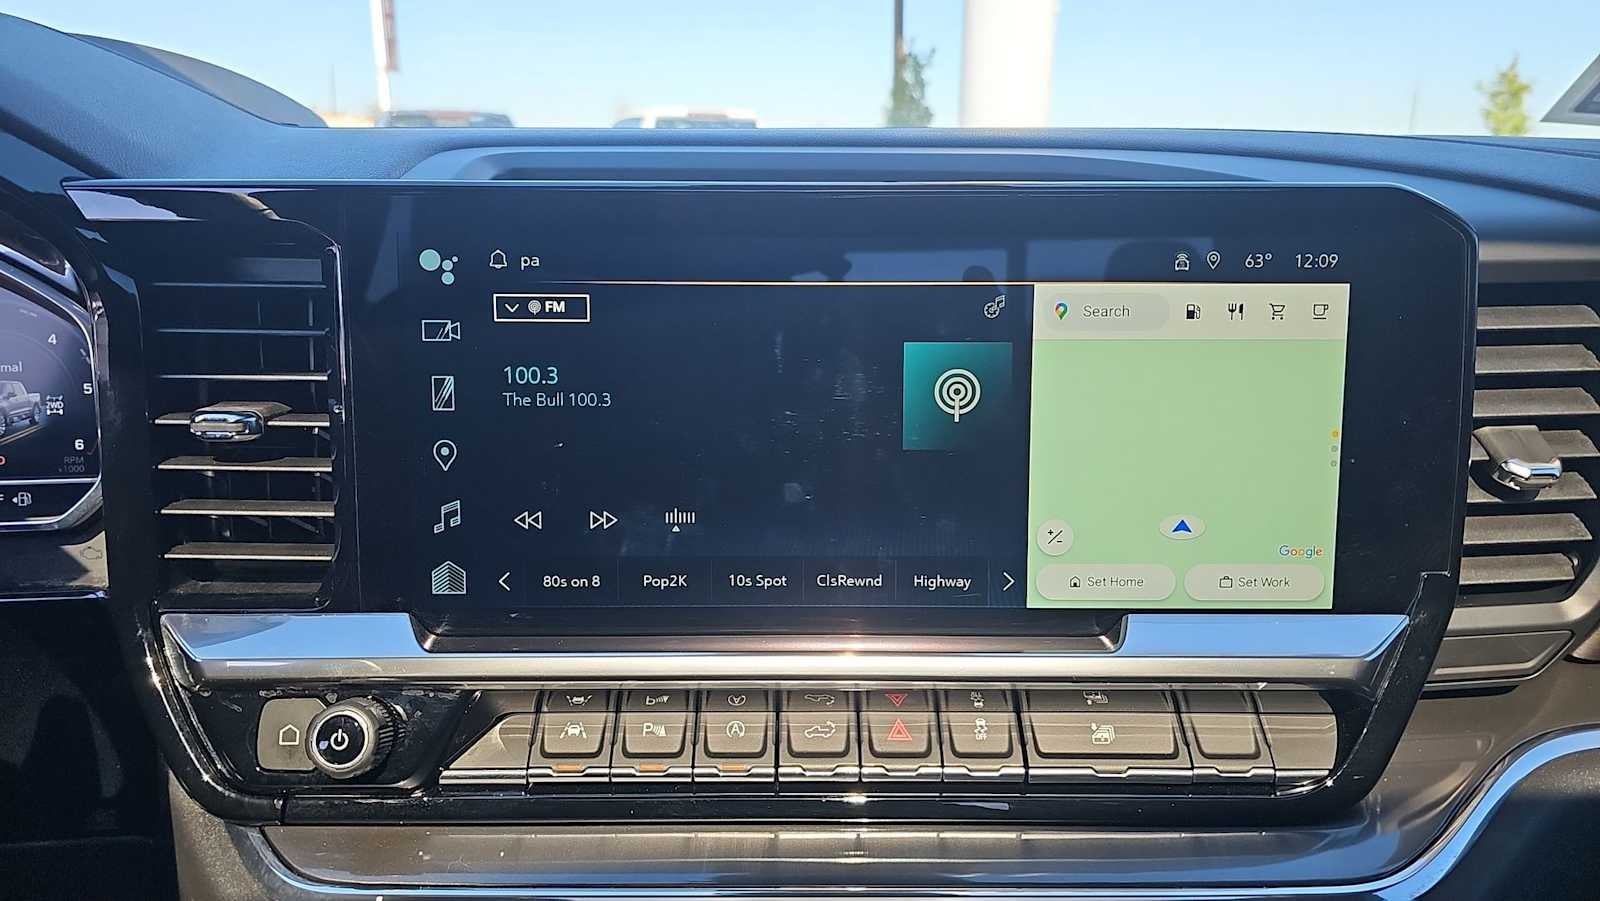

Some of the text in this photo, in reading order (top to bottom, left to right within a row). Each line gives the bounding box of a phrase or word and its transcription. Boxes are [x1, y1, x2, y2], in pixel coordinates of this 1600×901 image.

[520, 255, 540, 270] pa
[1294, 253, 1339, 269] 12:09
[545, 301, 565, 313] FM
[1082, 304, 1130, 318] Search
[48, 334, 57, 345] 4
[503, 366, 558, 384] 100.3
[83, 383, 93, 395] 5
[503, 391, 612, 407] The Bull 100.3
[74, 439, 84, 450] 6
[63, 456, 84, 464] RPM
[1278, 544, 1323, 559] Google
[543, 575, 601, 588] 80s on 8
[643, 575, 688, 590] Pop2K
[729, 574, 788, 589] 10s Spot
[816, 574, 883, 588] ClsRewnd
[913, 575, 972, 590] Highway
[1087, 575, 1144, 588] Set Home
[1238, 575, 1290, 589] Set Work
